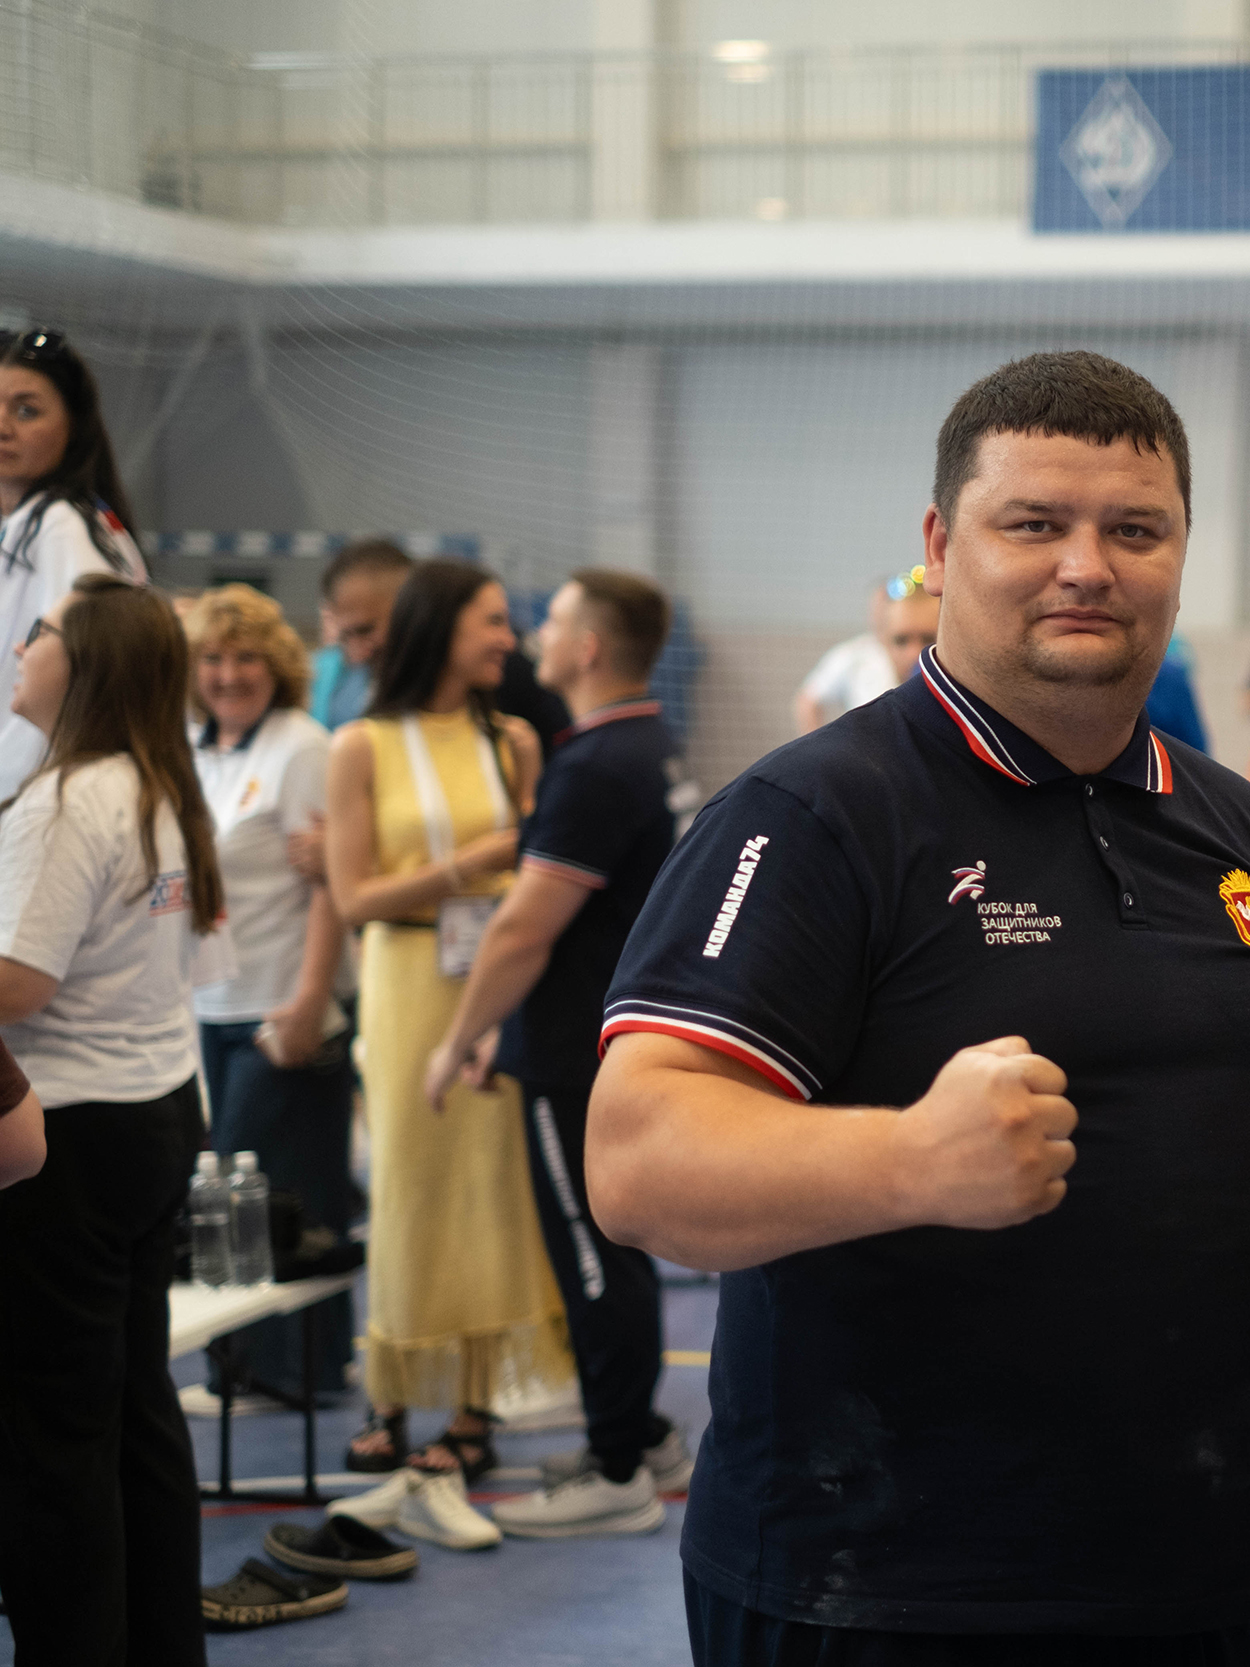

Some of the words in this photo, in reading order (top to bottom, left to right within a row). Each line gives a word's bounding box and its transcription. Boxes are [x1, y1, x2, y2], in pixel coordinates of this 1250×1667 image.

[702, 835, 770, 957] КОМАНДА74
[977, 902, 1013, 914] КУБОК
[1015, 903, 1038, 916] ДЛЯ
[981, 916, 1062, 930] ЗАЩИТНИКОВ
[985, 931, 1051, 945] ОТЕЧЕСТВА
